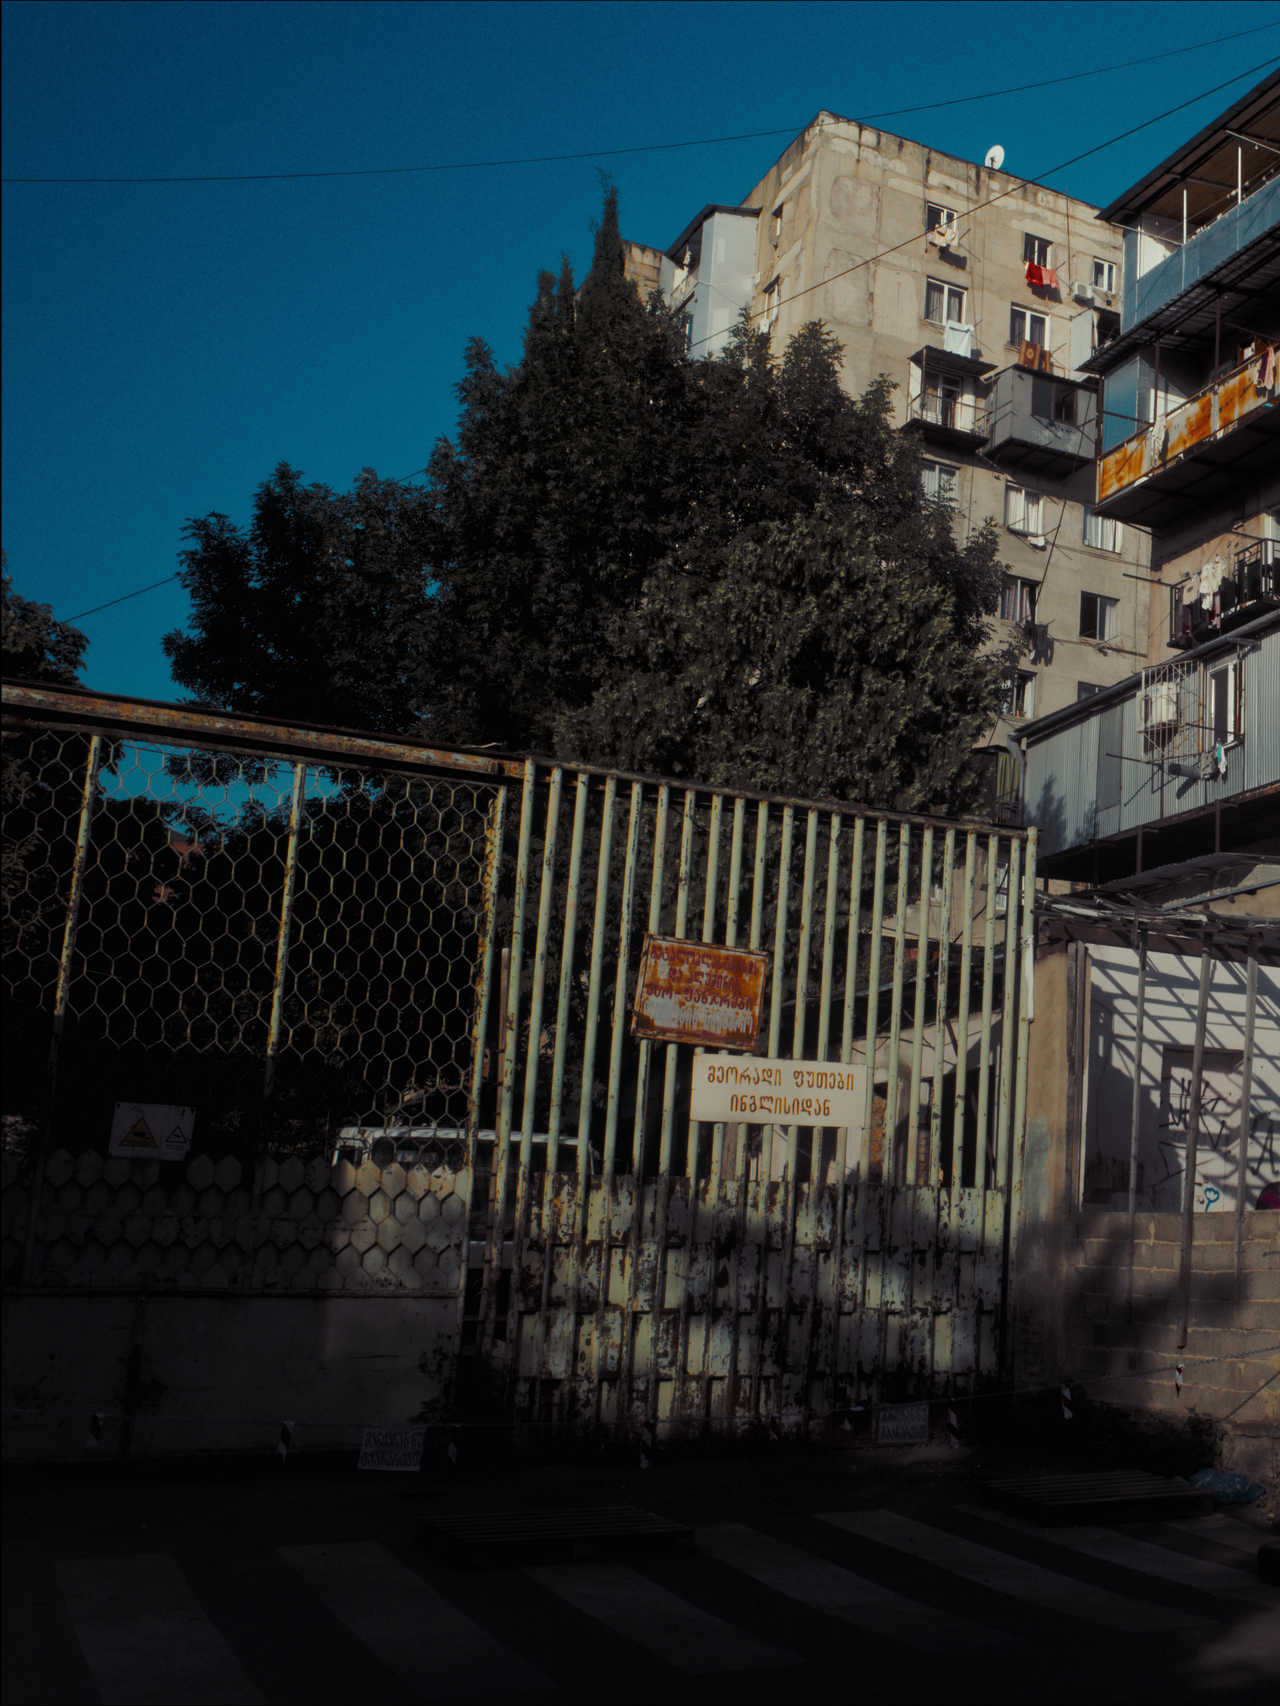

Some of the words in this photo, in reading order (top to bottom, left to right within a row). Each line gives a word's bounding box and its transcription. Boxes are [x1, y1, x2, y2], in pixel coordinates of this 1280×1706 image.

[668, 966, 683, 983] და
[707, 1065, 782, 1086] მეორადი
[793, 1069, 855, 1091] ფუთები
[730, 1093, 832, 1117] ინგლისიდან
